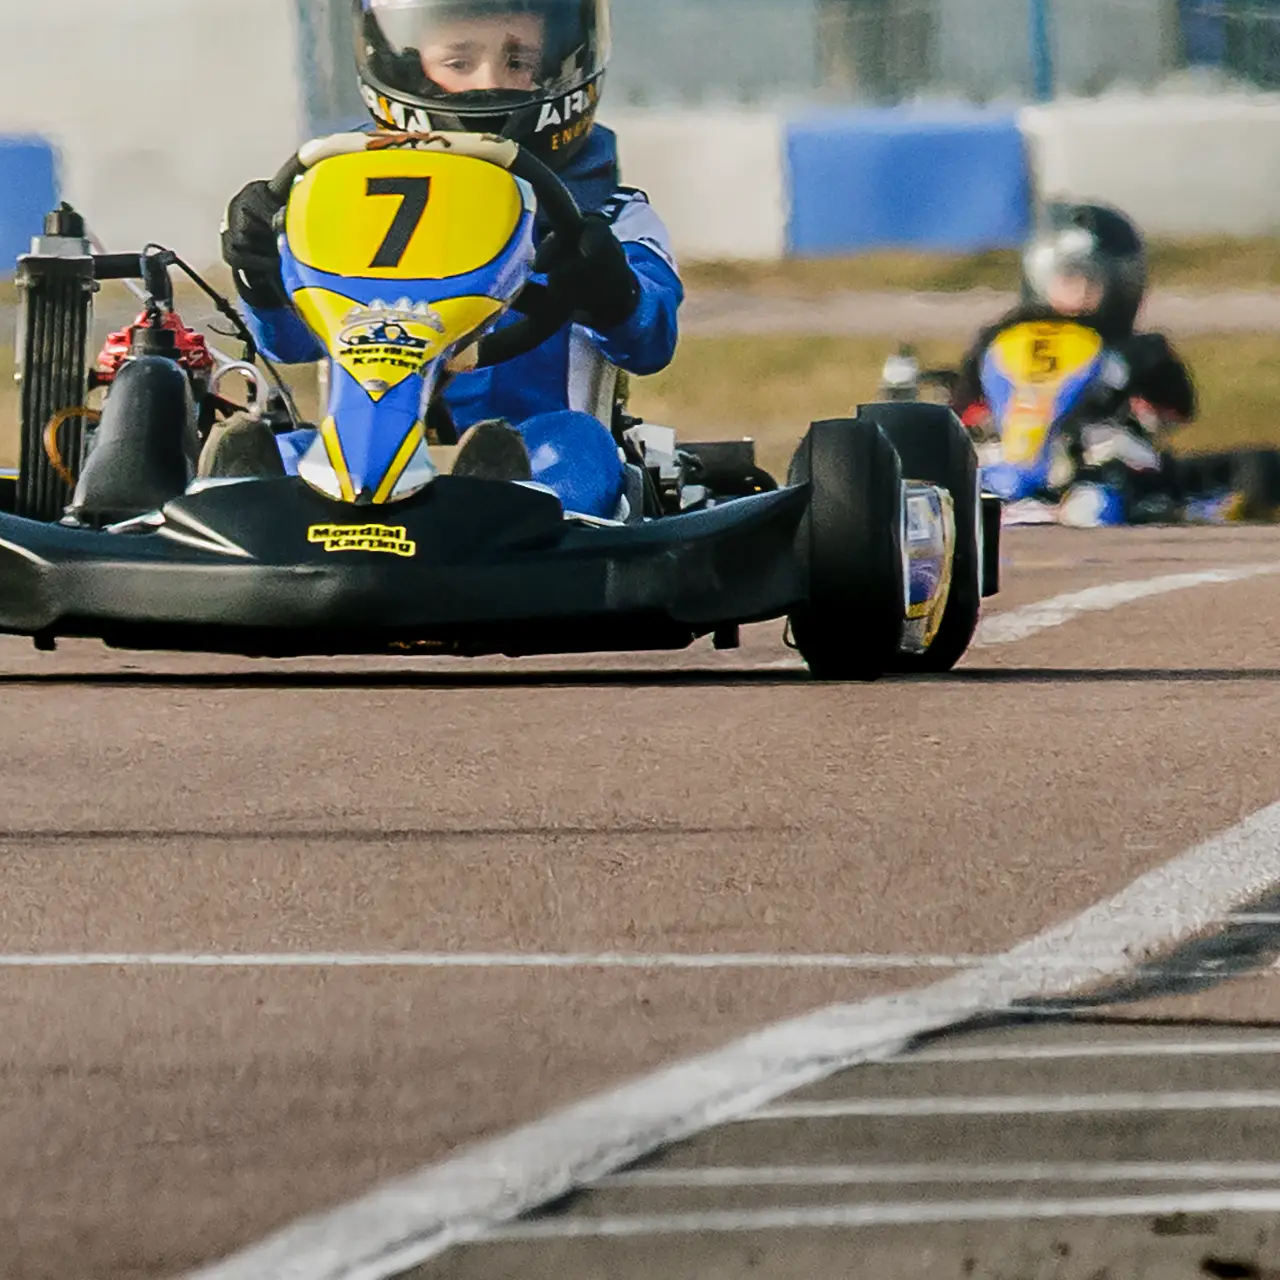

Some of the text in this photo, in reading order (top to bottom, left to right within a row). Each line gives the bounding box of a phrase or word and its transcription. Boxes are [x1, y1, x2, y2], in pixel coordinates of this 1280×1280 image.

[366, 176, 431, 268] 7
[312, 526, 401, 539] Mondial
[329, 539, 411, 553] Karting
